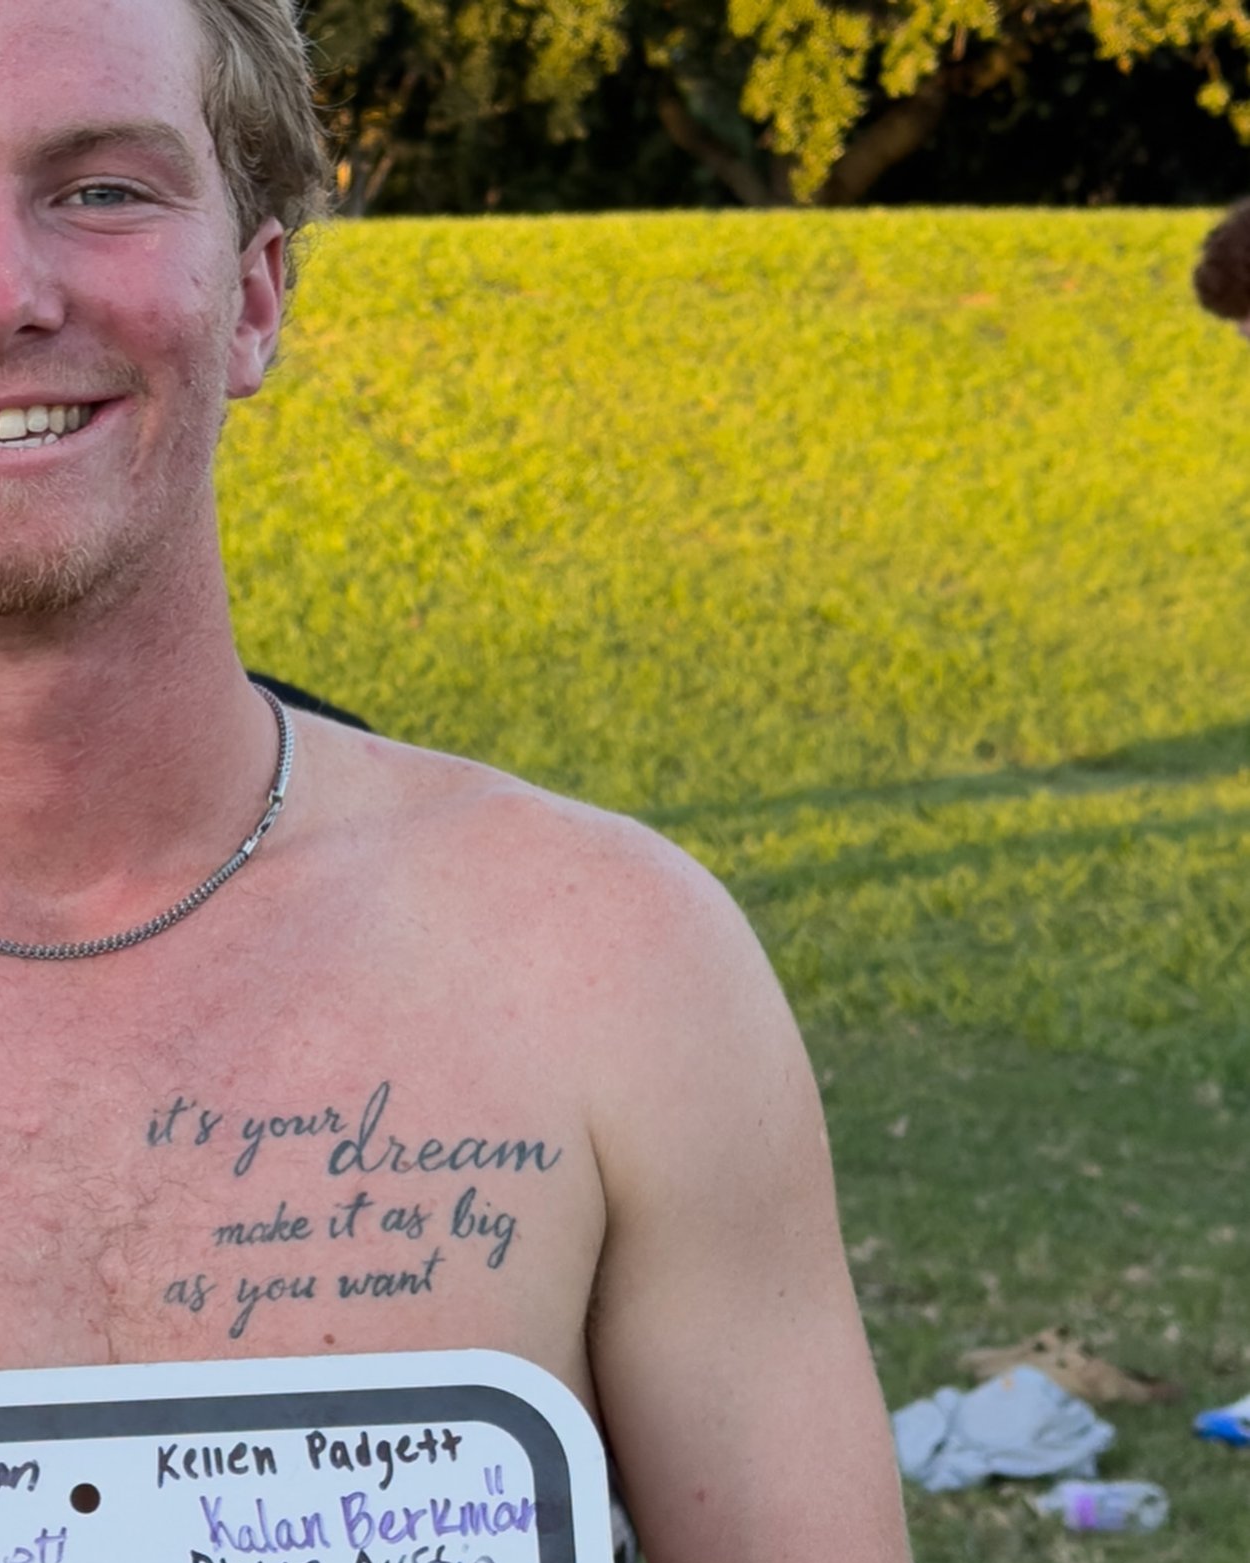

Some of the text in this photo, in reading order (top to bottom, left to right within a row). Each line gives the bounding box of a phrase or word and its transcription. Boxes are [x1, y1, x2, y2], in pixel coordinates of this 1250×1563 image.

[146, 1079, 564, 1178] it's your dream
[213, 1186, 517, 1269] make it as big
[163, 1247, 447, 1340] as you want
[157, 1428, 463, 1491] Kellen Padgett
